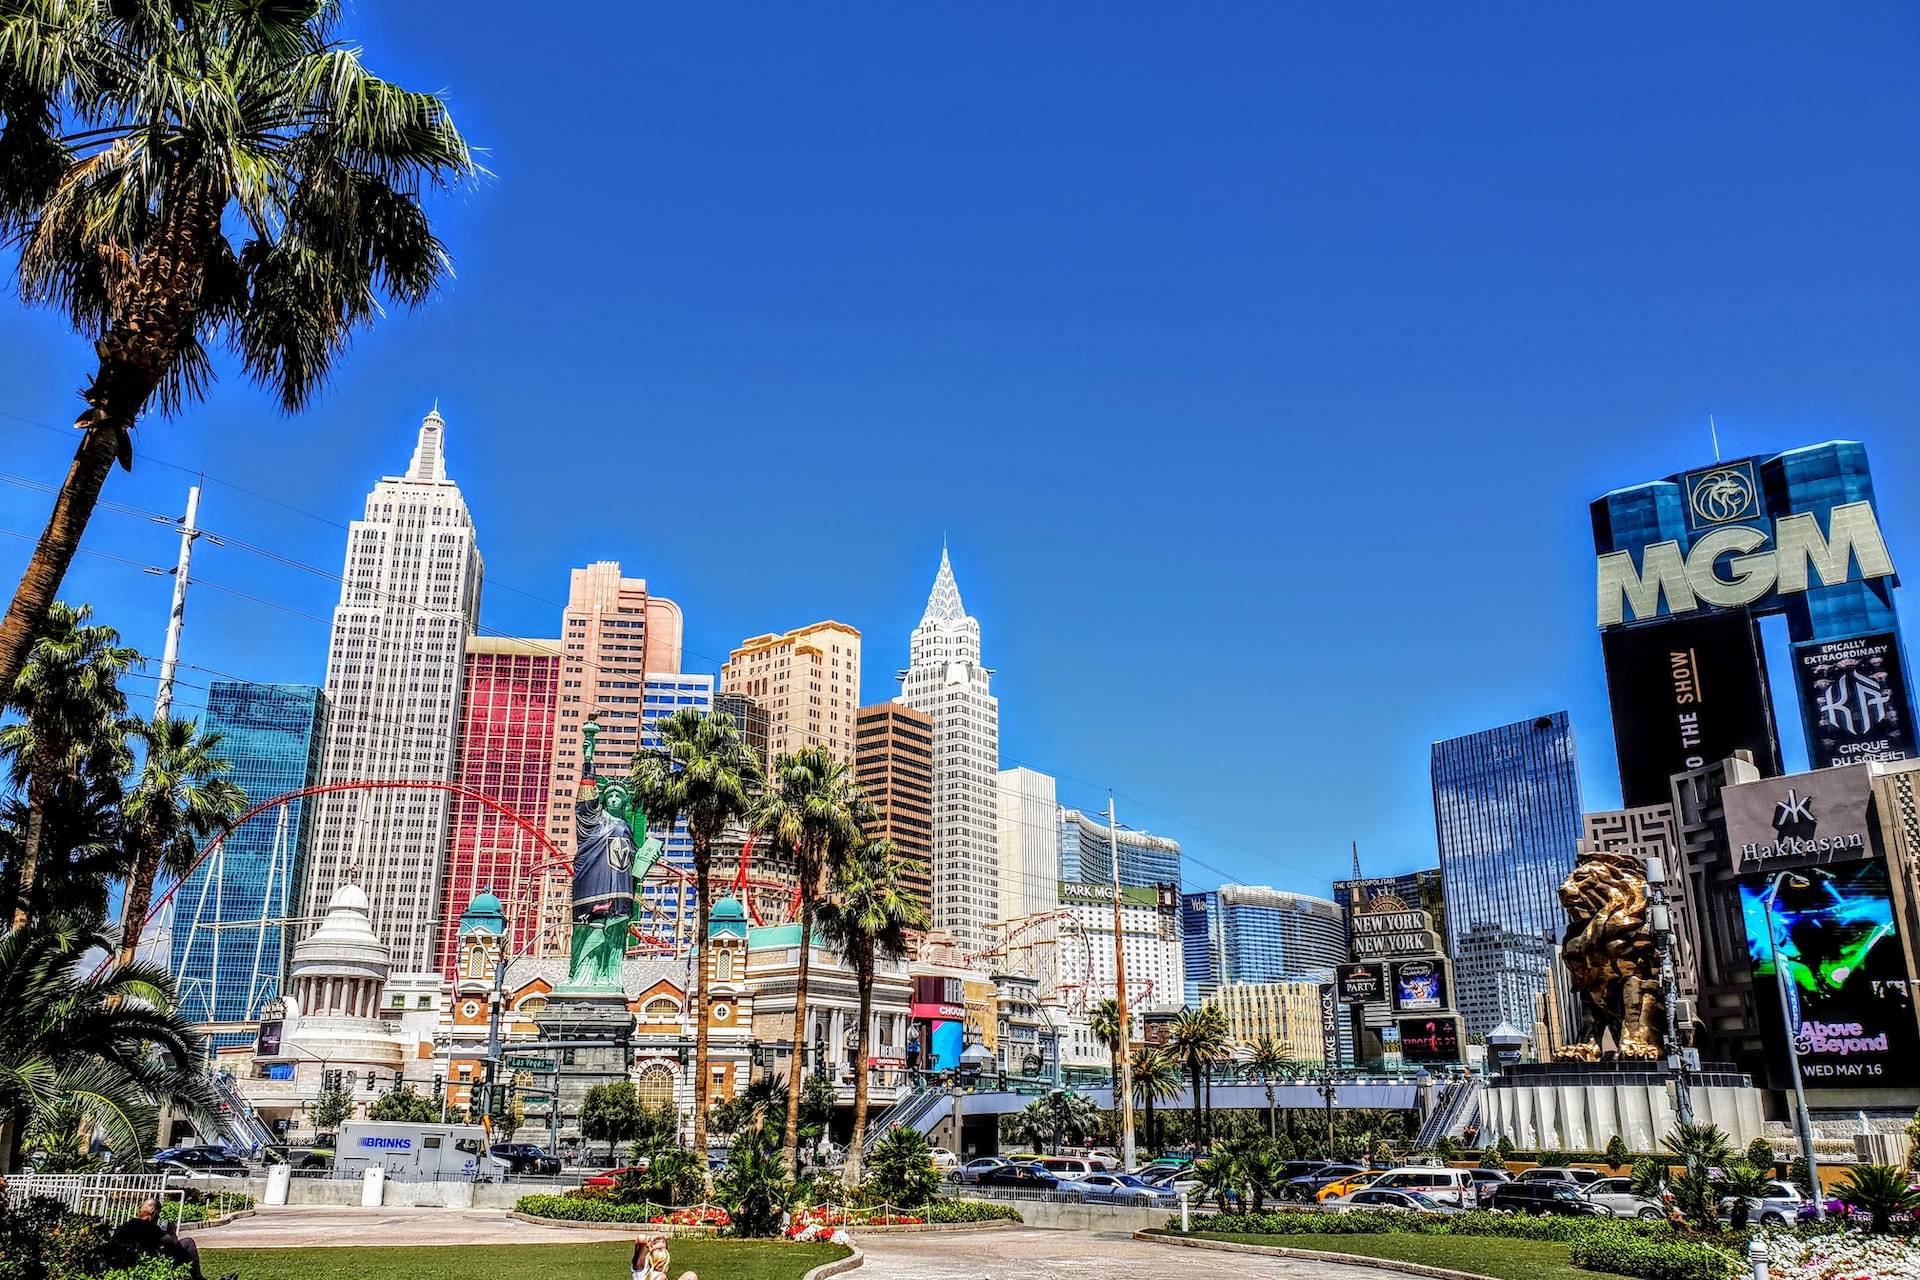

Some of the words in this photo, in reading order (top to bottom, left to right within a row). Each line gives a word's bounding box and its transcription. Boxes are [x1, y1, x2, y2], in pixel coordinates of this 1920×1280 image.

[1597, 500, 1895, 628] MGM
[1803, 645, 1888, 665] EXTRAORDINARY
[1822, 640, 1866, 653] EPICALLY
[1670, 652, 1694, 704] SHOW
[1679, 712, 1700, 748] THE
[1839, 740, 1890, 754] CIRQUE
[1831, 757, 1851, 767] DU
[1742, 832, 1864, 861] Hakkasan
[1064, 884, 1092, 897] PARK
[1353, 917, 1383, 933] NEW
[1386, 912, 1423, 930] YORK
[1355, 936, 1385, 953] NEW
[1388, 932, 1425, 951] YORK
[1322, 992, 1335, 1032] SHACK
[1800, 1020, 1863, 1037] Above
[1811, 1032, 1889, 1056] Beyond
[512, 1057, 525, 1066] Las
[526, 1058, 546, 1069] Vegas
[1803, 1065, 1834, 1077] WED
[1836, 1064, 1863, 1076] MAY
[1866, 1063, 1883, 1075] 16
[366, 1137, 412, 1149] BRINKS
